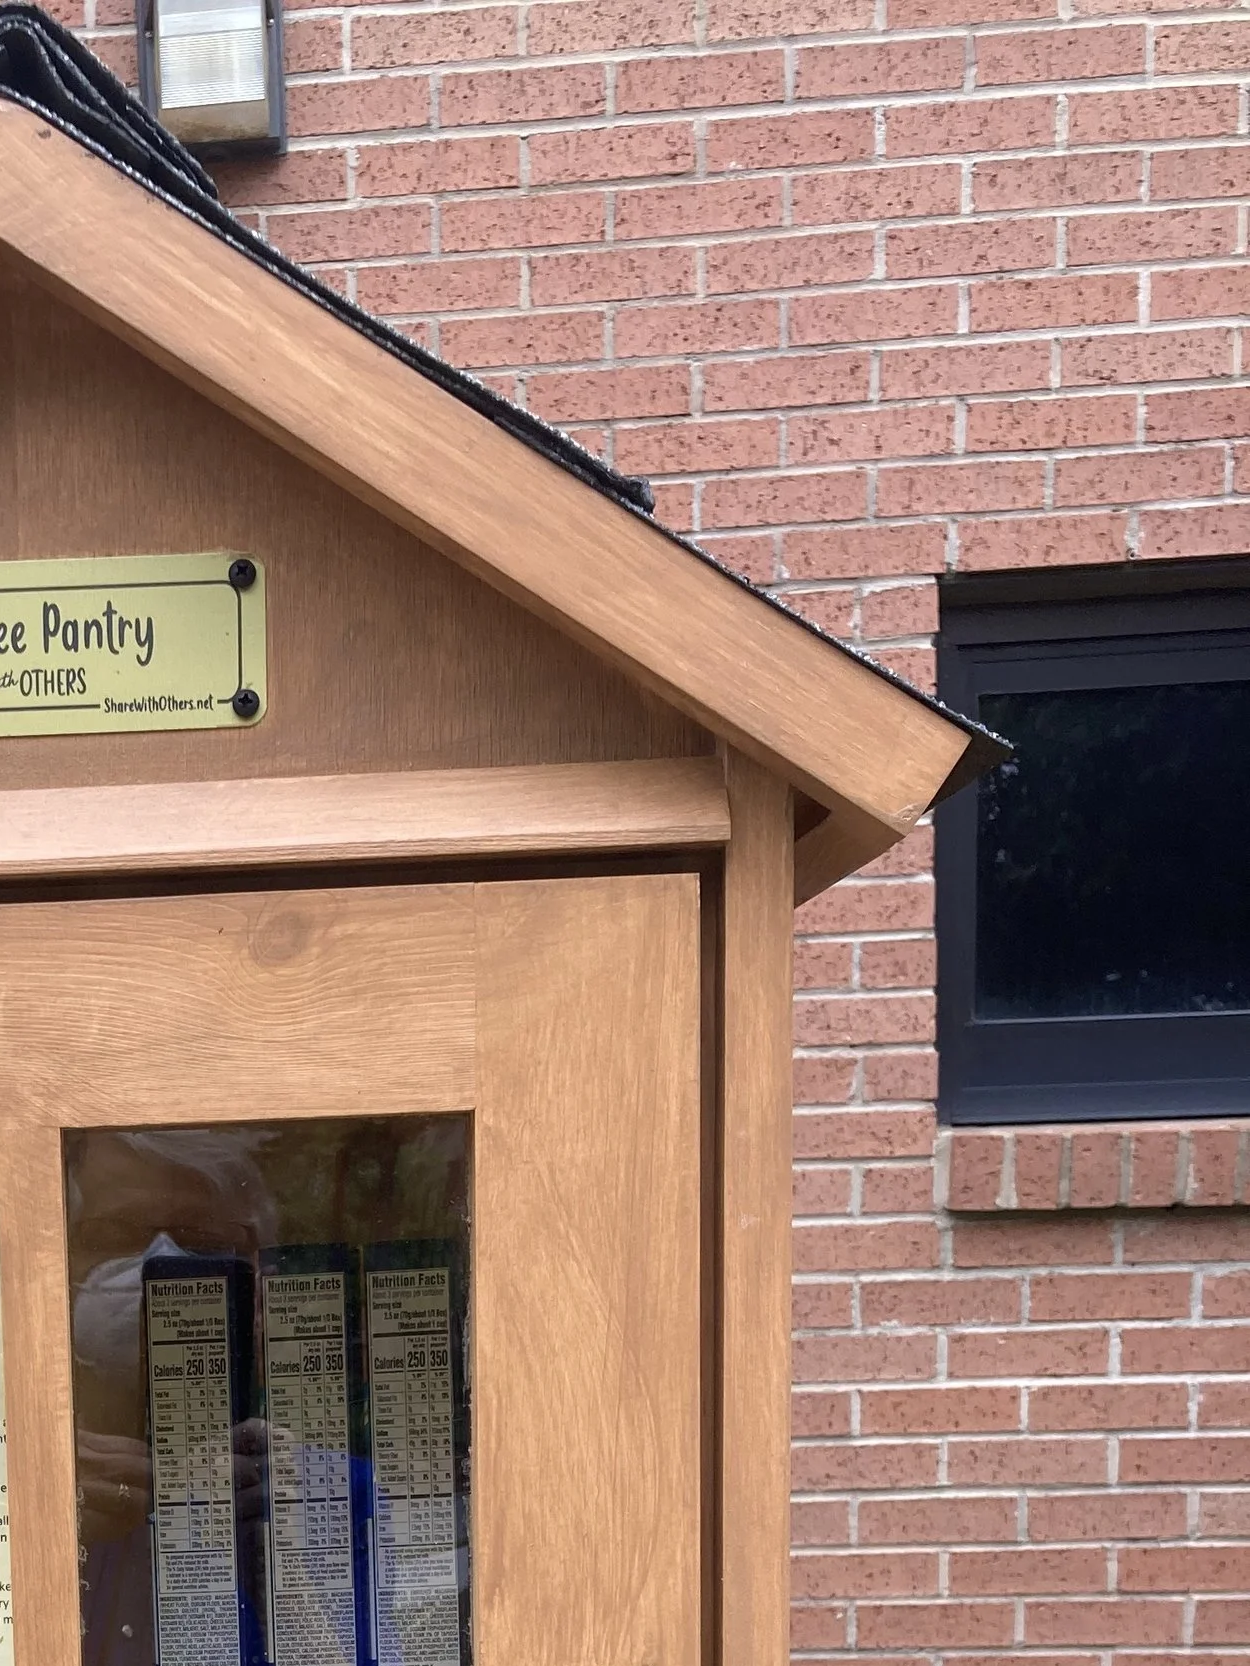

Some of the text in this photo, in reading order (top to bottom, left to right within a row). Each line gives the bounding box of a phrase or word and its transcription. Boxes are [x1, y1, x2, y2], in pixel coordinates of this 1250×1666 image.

[43, 601, 154, 666] Pantry
[20, 669, 86, 697] OTHERS
[104, 695, 213, 714] ShareWithOthers.net
[151, 1281, 224, 1297] Nutrition Facts
[268, 1278, 340, 1292] Nutrition Facts
[372, 1274, 445, 1288] Nutrition Facts
[154, 1358, 226, 1377] Calories 250 350
[270, 1354, 343, 1374] Calories 250 350
[374, 1350, 447, 1369] Calories 250 350
